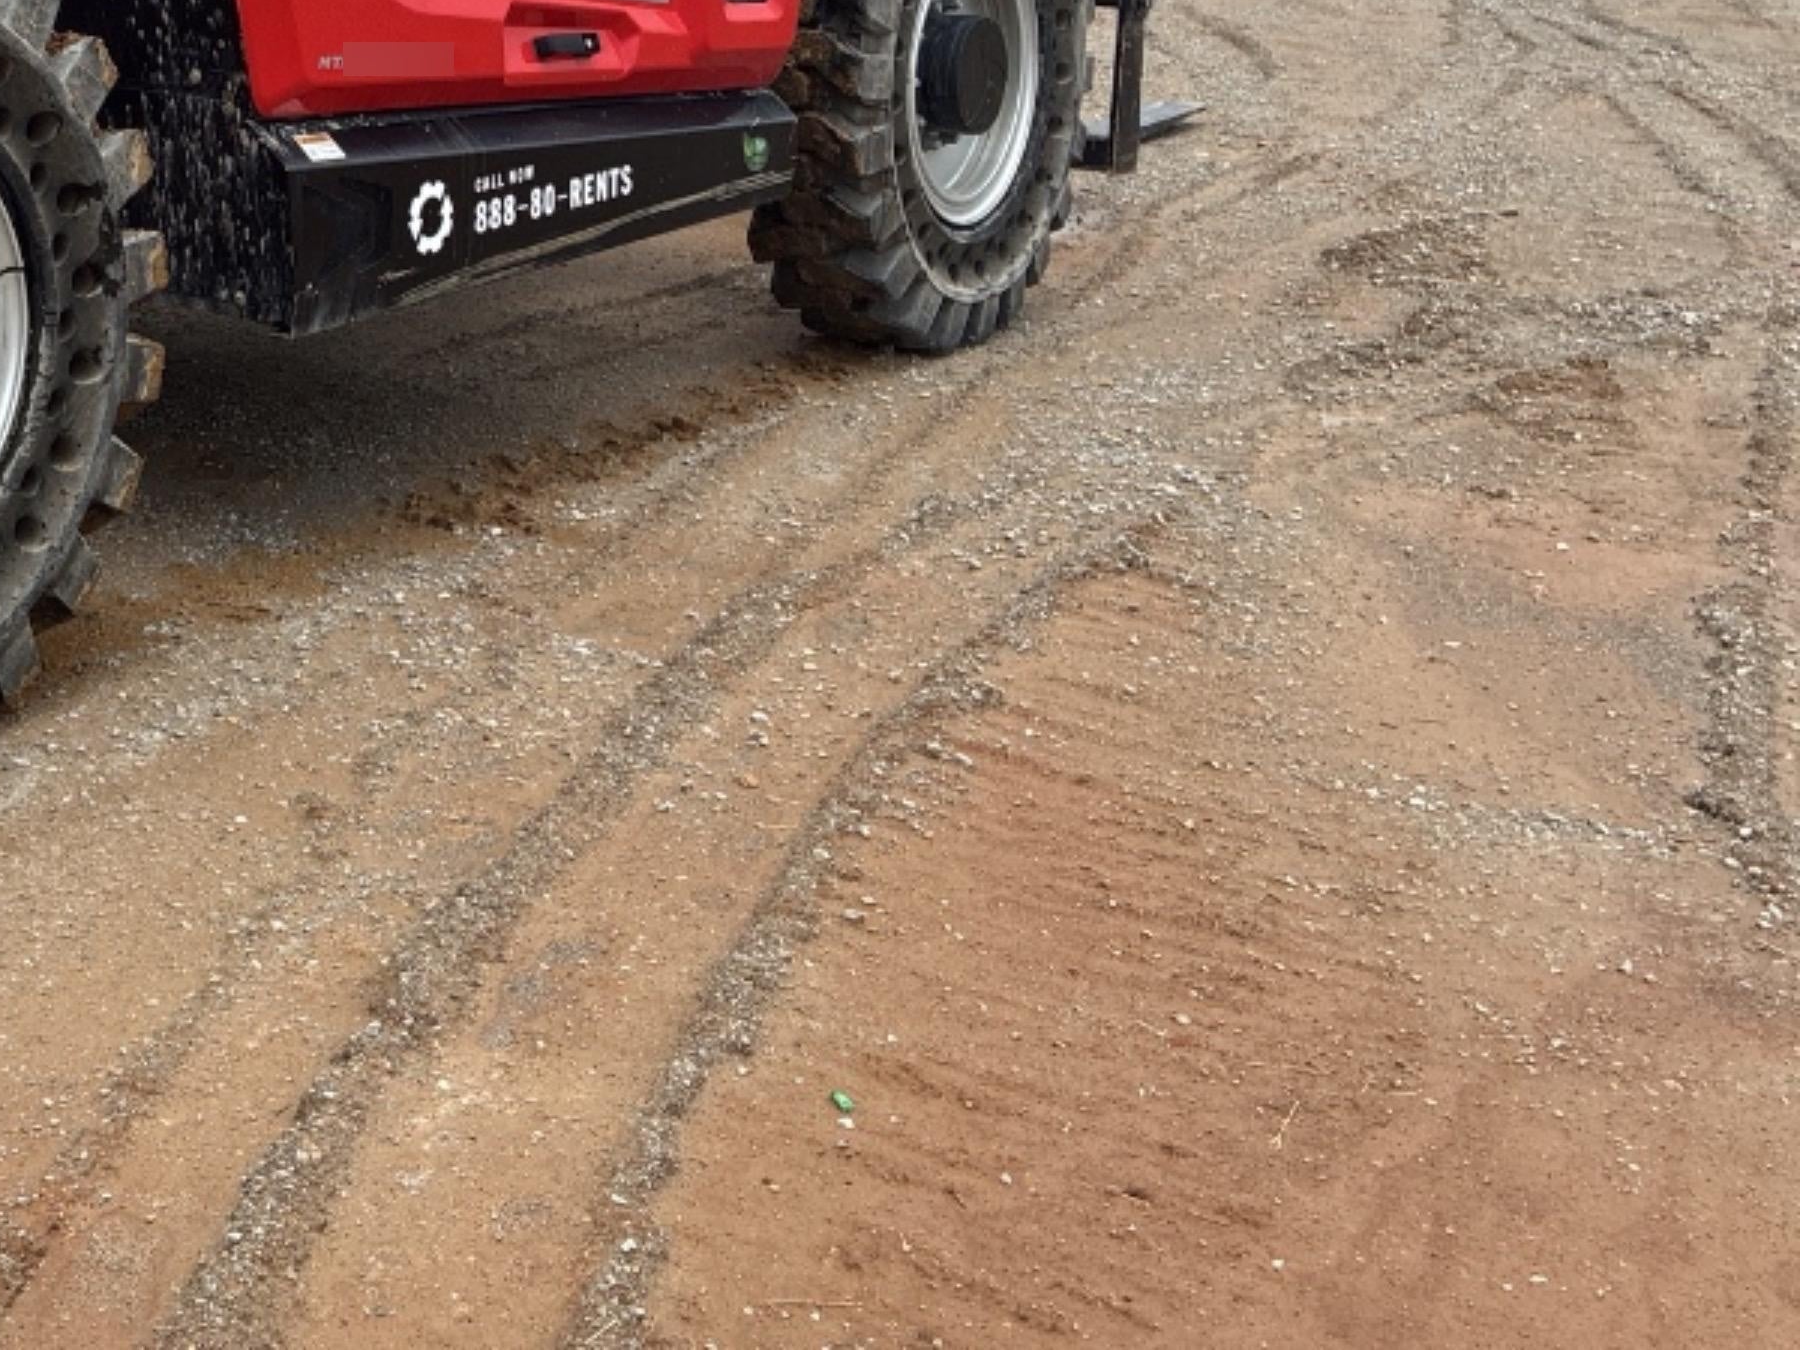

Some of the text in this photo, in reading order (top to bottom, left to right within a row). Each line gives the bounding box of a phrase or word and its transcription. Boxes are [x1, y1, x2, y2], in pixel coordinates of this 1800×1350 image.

[474, 164, 535, 193] CALL NOW
[474, 164, 633, 234] 888-80-RENTS
